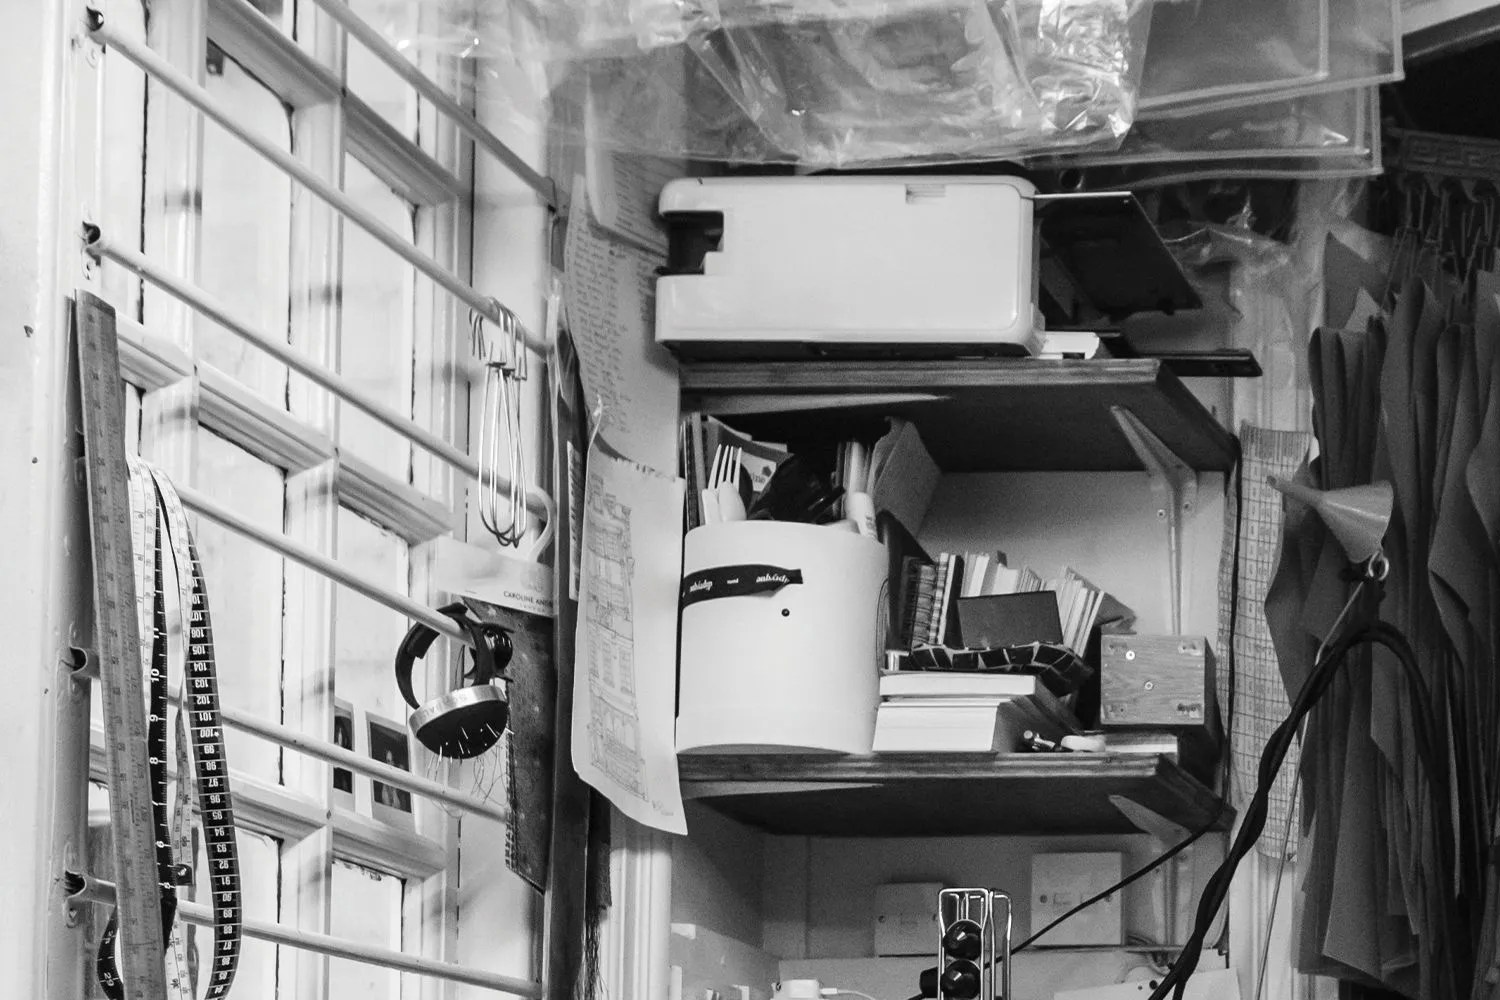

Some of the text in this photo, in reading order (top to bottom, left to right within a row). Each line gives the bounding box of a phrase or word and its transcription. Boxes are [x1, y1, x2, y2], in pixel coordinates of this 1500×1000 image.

[191, 628, 204, 638] 106
[192, 645, 206, 655] 105
[193, 662, 207, 672] 104
[151, 668, 160, 683] 10
[195, 679, 208, 688] 103
[197, 695, 210, 705] 102
[149, 714, 158, 722] 9
[199, 712, 212, 721] 101
[200, 728, 214, 738] 100
[150, 757, 159, 765] 8
[208, 777, 218, 787] 97
[214, 827, 224, 837] 94
[217, 843, 227, 853] 93
[219, 860, 229, 869] 92
[221, 876, 230, 885] 91
[223, 941, 231, 950] 87
[103, 972, 114, 986] 29
